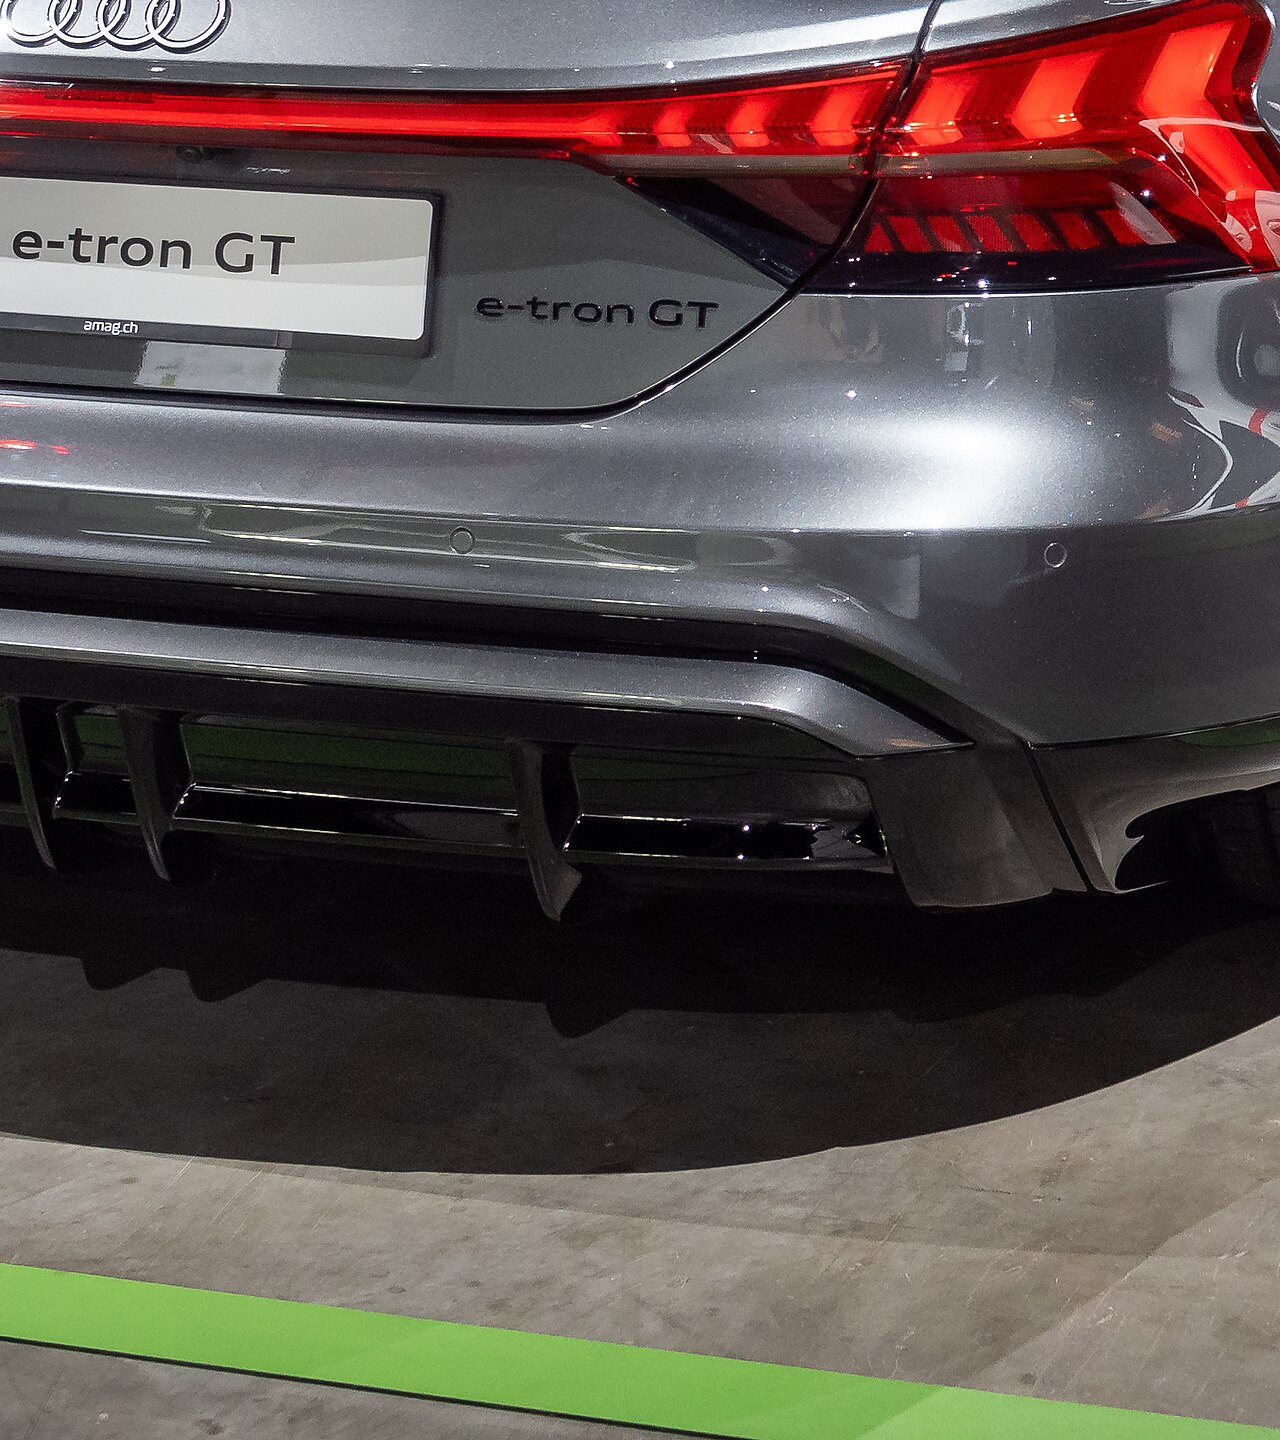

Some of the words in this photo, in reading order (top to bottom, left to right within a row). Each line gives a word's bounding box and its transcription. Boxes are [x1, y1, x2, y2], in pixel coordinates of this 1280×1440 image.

[12, 227, 192, 270] e-tron
[215, 232, 296, 276] GT
[83, 319, 139, 336] amag.ch
[476, 296, 636, 325] e-tron
[648, 299, 720, 329] GT
